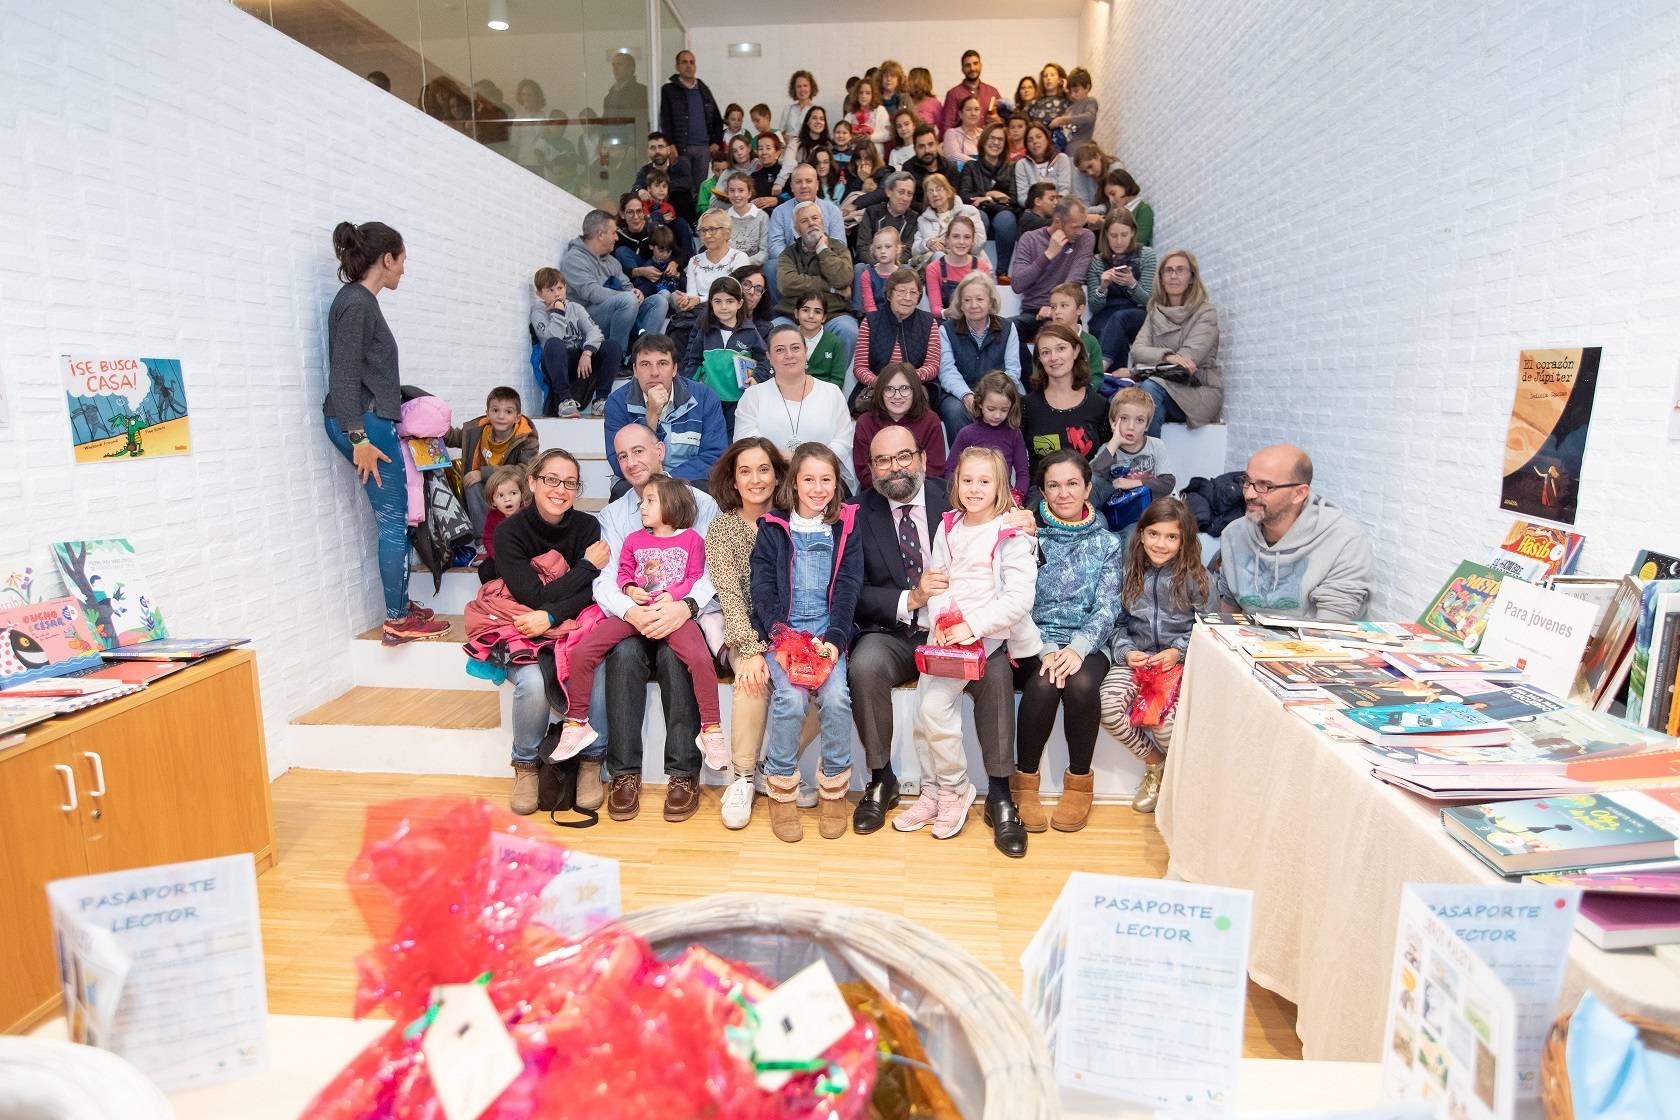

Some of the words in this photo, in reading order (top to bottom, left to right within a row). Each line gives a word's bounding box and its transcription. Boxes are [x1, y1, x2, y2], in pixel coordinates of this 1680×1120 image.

[99, 359, 138, 372] BUSCA
[1523, 360, 1534, 370] El
[1536, 357, 1575, 370] corazón
[86, 373, 137, 392] CASA!
[1521, 372, 1532, 382] de
[1533, 370, 1573, 384] Júpiter
[1517, 534, 1551, 559] Hasib
[1504, 601, 1528, 622] Para
[1528, 609, 1574, 639] jóvenes
[79, 877, 218, 911] PASAPORTE
[1093, 895, 1214, 919] PASAPORTE
[112, 906, 200, 933] LECTOR
[1115, 922, 1193, 943] LECTOR
[1454, 928, 1518, 942] ECTOR
